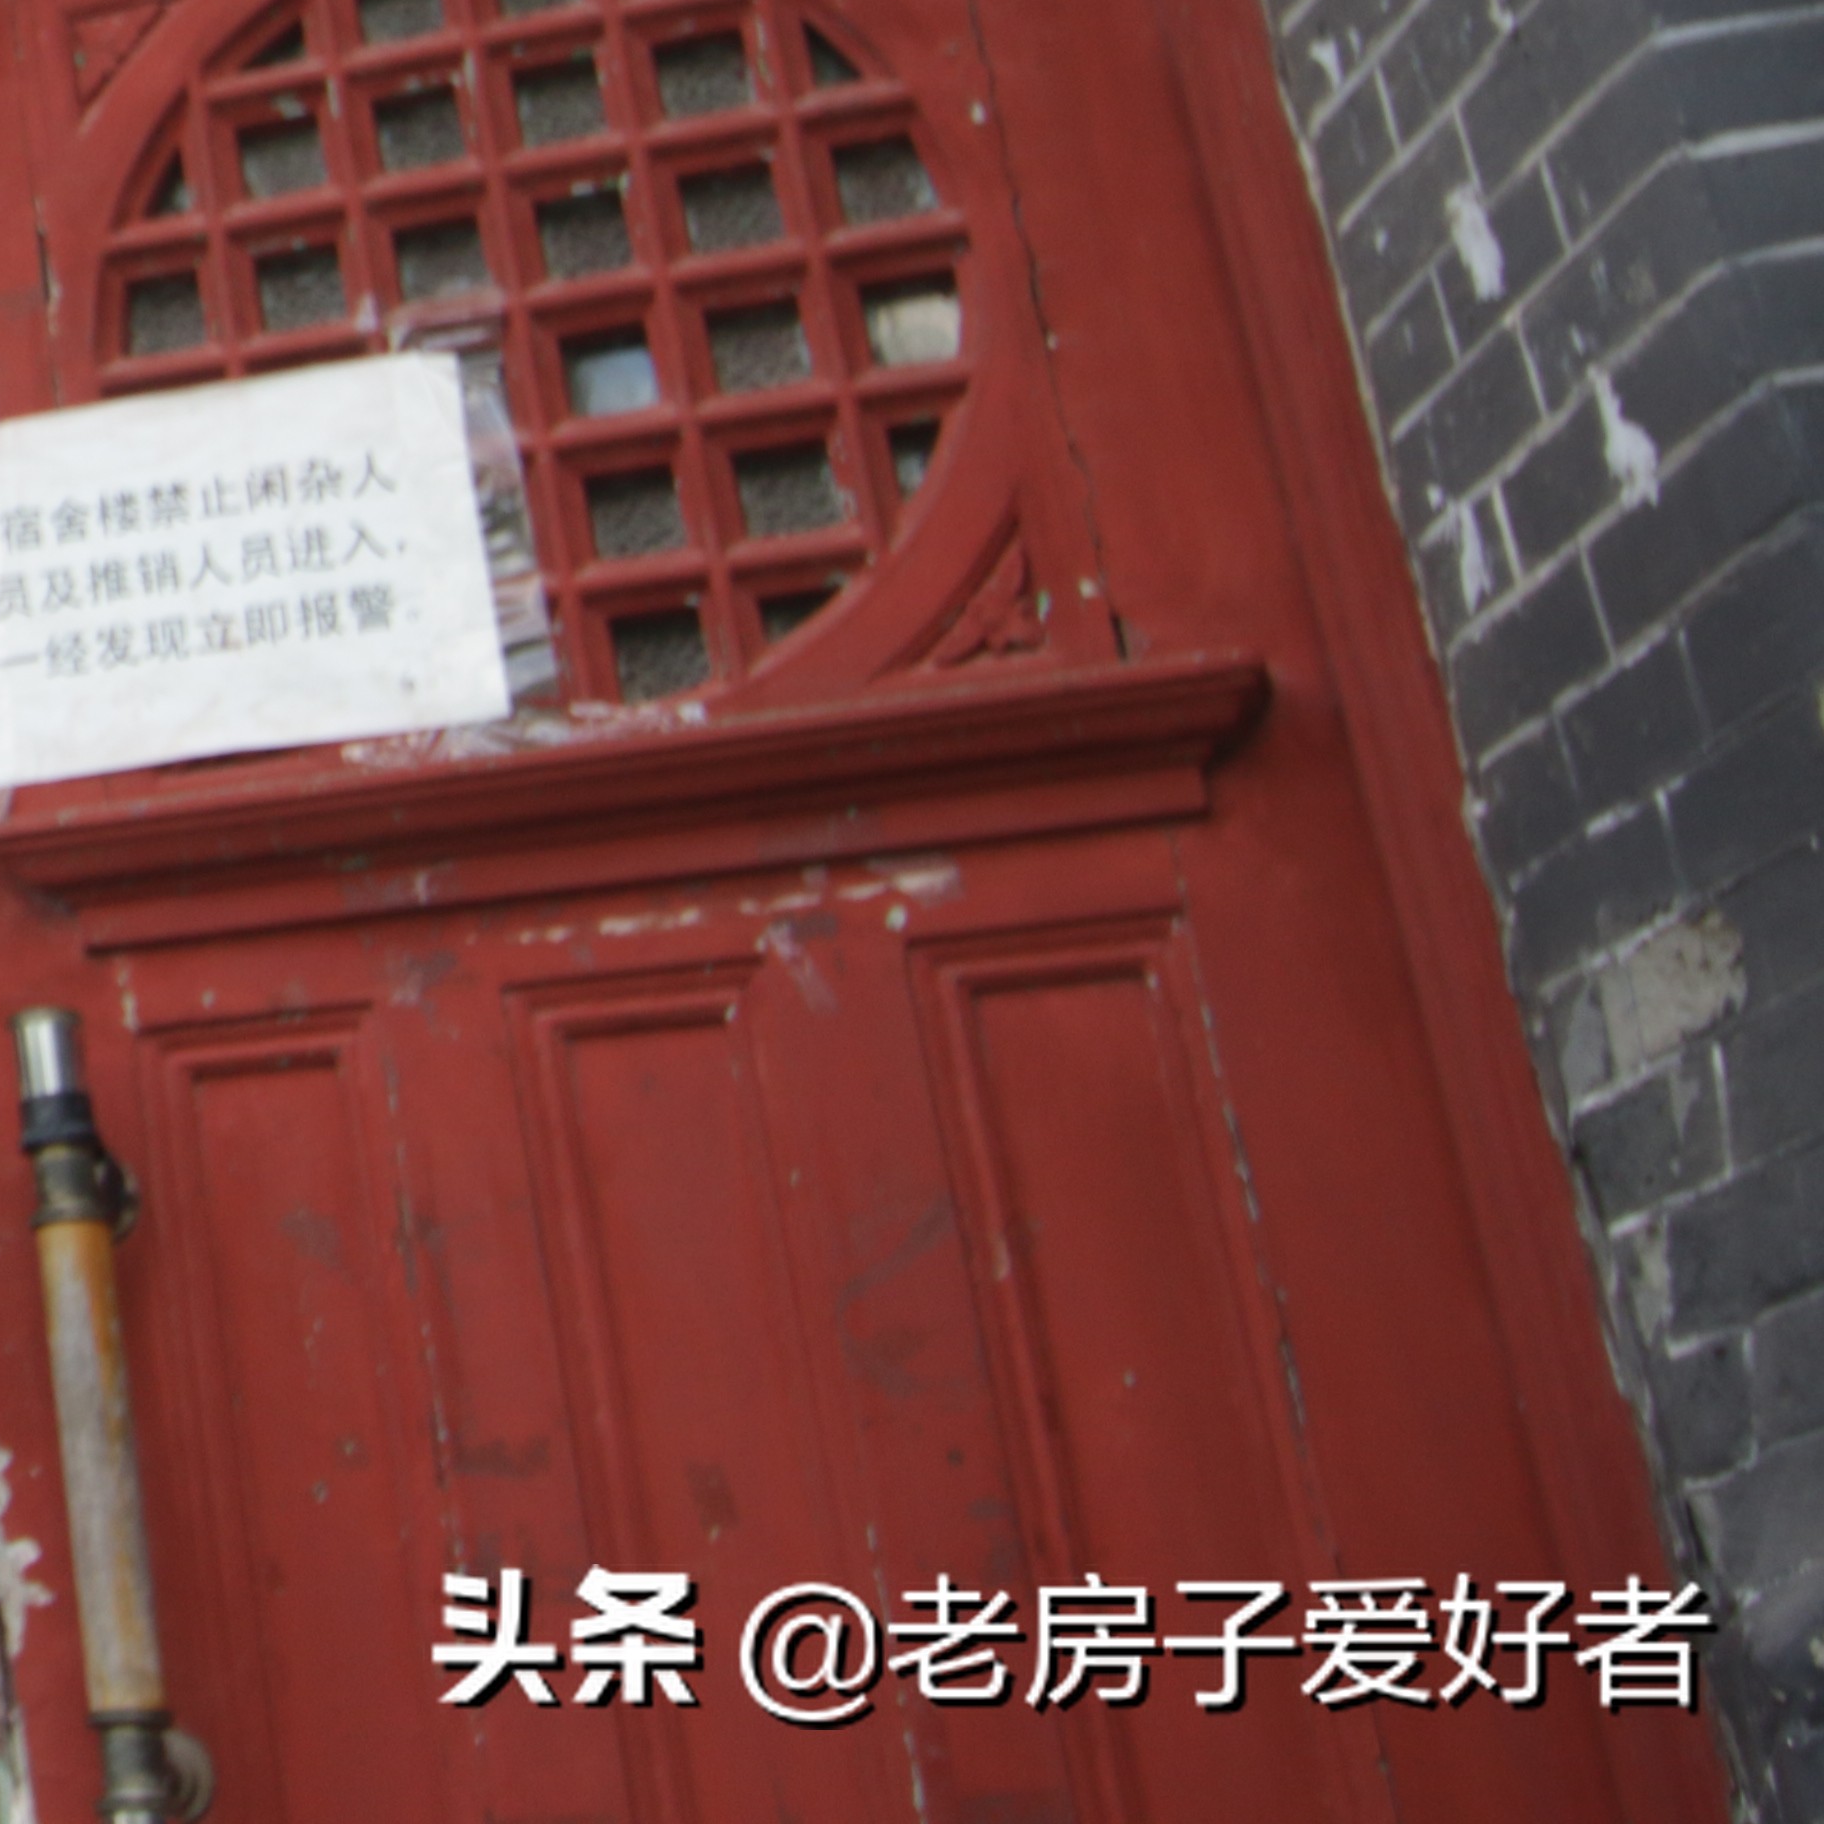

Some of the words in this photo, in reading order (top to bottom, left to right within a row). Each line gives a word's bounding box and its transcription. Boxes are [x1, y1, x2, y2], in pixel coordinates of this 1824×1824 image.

[0, 450, 398, 554] 宿舍楼禁止闲杂人
